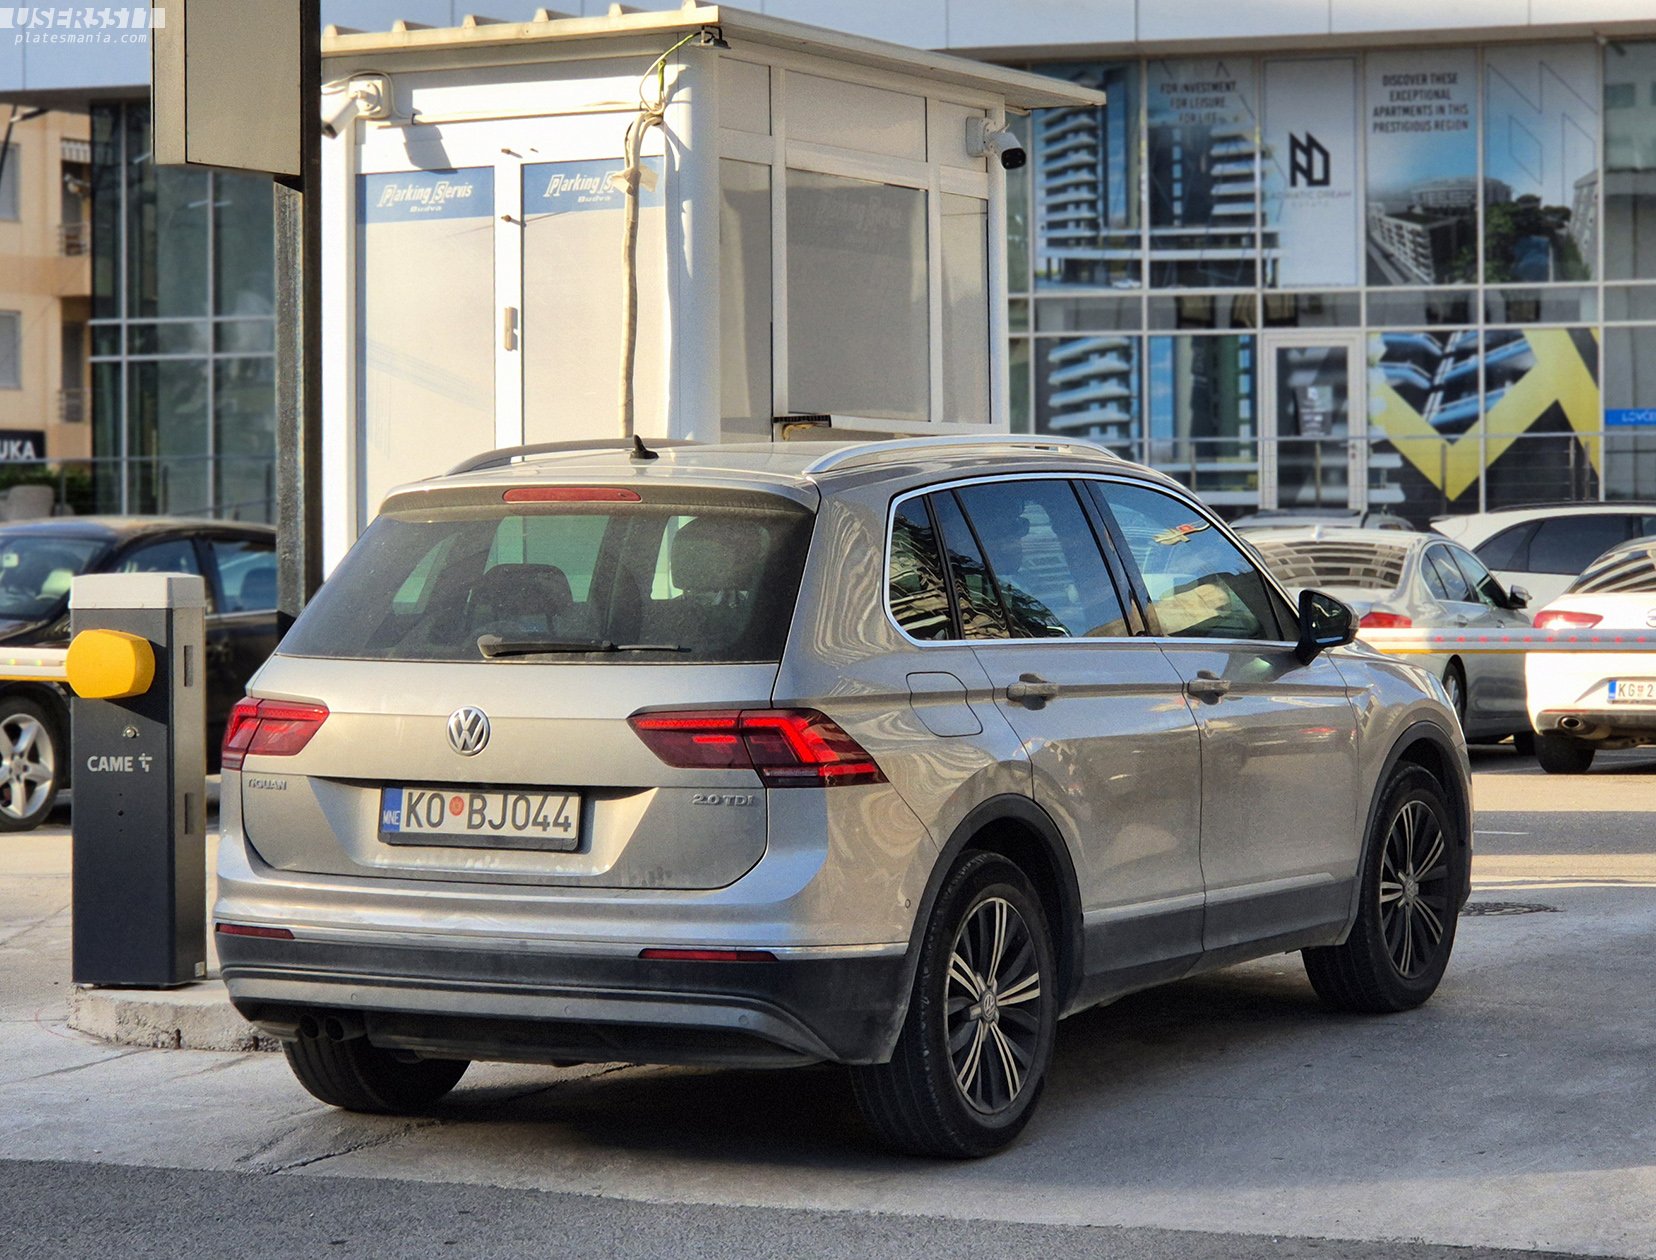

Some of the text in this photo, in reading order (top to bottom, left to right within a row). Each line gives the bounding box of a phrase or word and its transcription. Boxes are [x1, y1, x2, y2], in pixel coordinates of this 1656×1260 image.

[1382, 72, 1458, 87] DISCOVER THESE
[1160, 81, 1236, 95] FOR INVESTMENT
[1389, 88, 1451, 102] EXCEPTIONAL
[1373, 103, 1469, 117] APARTMENTS IN THIS
[1373, 119, 1469, 132] PRESTIGIOUS REGION
[543, 173, 601, 197] Parking
[376, 181, 473, 208] Parking Servis
[1618, 683, 1635, 697] KG
[1647, 684, 1654, 697] 2
[87, 755, 134, 772] CAME
[722, 794, 754, 806] TDI
[391, 791, 572, 833] MNE KO BJ044
